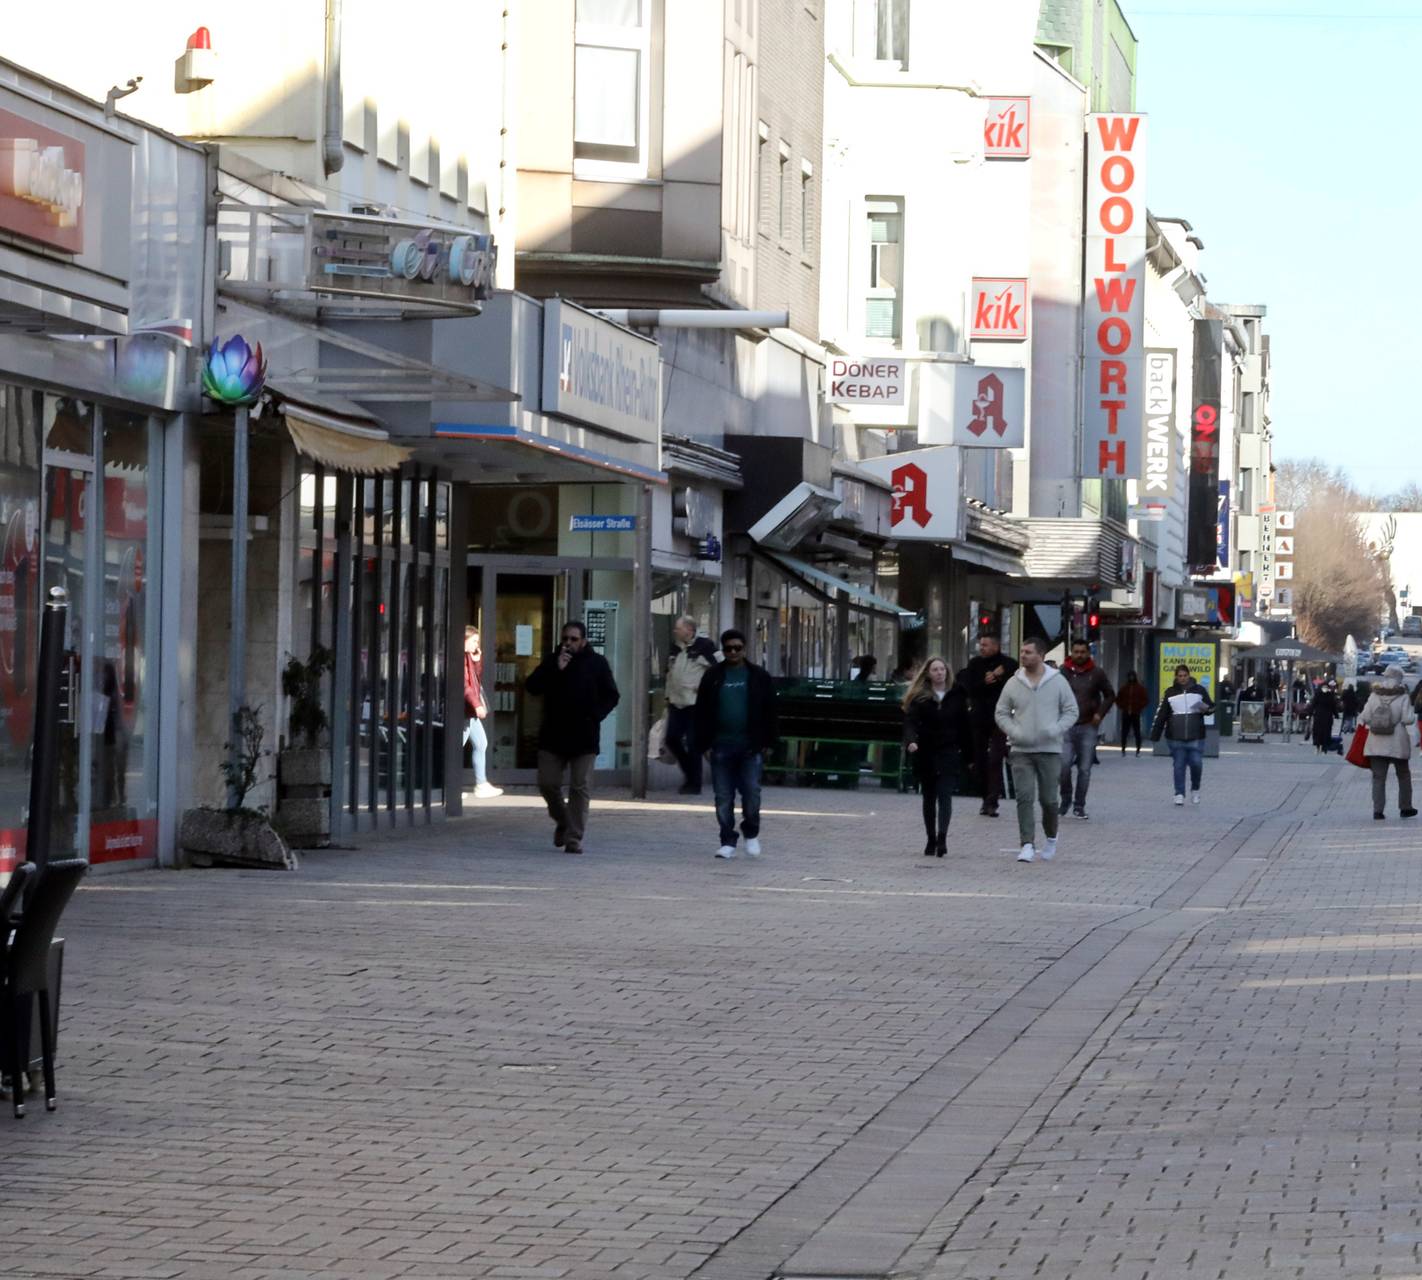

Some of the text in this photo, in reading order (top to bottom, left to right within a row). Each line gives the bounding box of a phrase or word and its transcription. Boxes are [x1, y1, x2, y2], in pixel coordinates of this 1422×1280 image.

[984, 107, 1024, 148] kik
[1094, 117, 1140, 476] WOOLWORTH
[974, 286, 1023, 330] kik
[832, 360, 899, 378] DÖNER
[831, 380, 898, 399] KEBAP
[573, 517, 631, 529] Elsässer Straße
[1163, 645, 1212, 657] MUTIG
